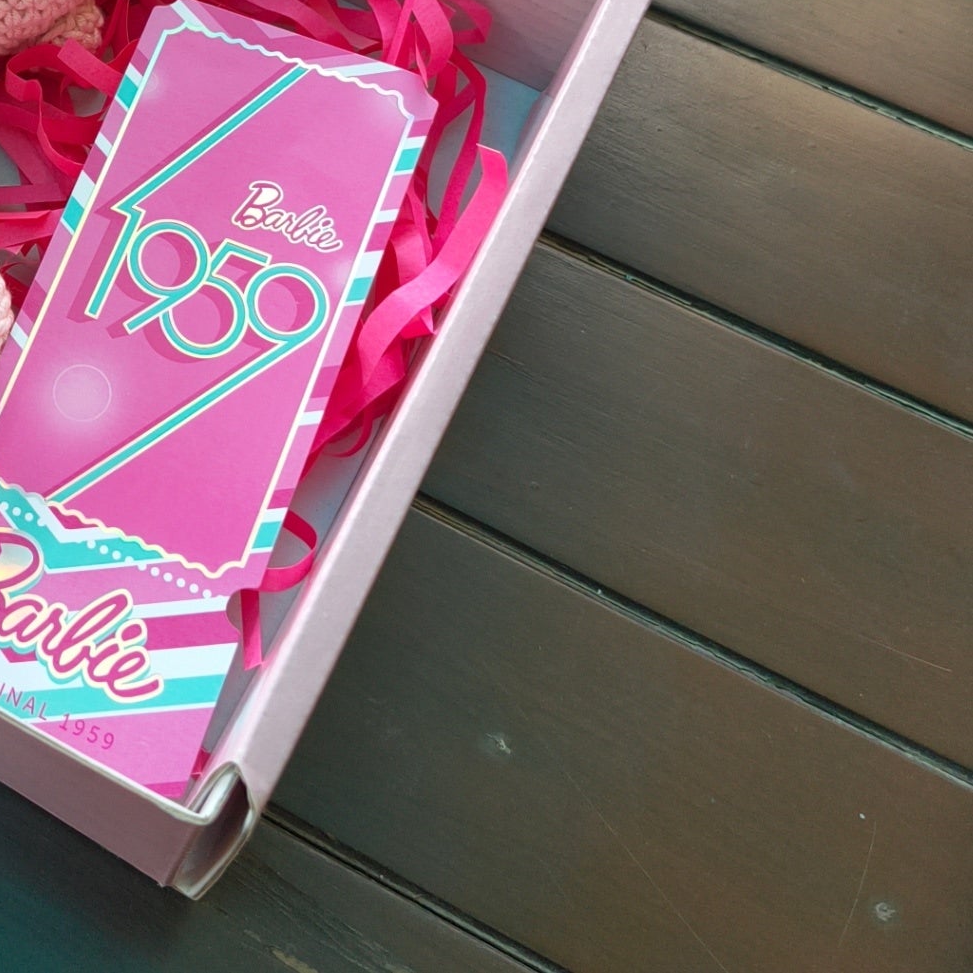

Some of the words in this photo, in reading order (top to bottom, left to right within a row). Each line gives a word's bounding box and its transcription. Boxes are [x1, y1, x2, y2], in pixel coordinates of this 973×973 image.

[232, 180, 344, 252] Barbie
[84, 206, 328, 358] 1959
[59, 713, 115, 750] 1959
